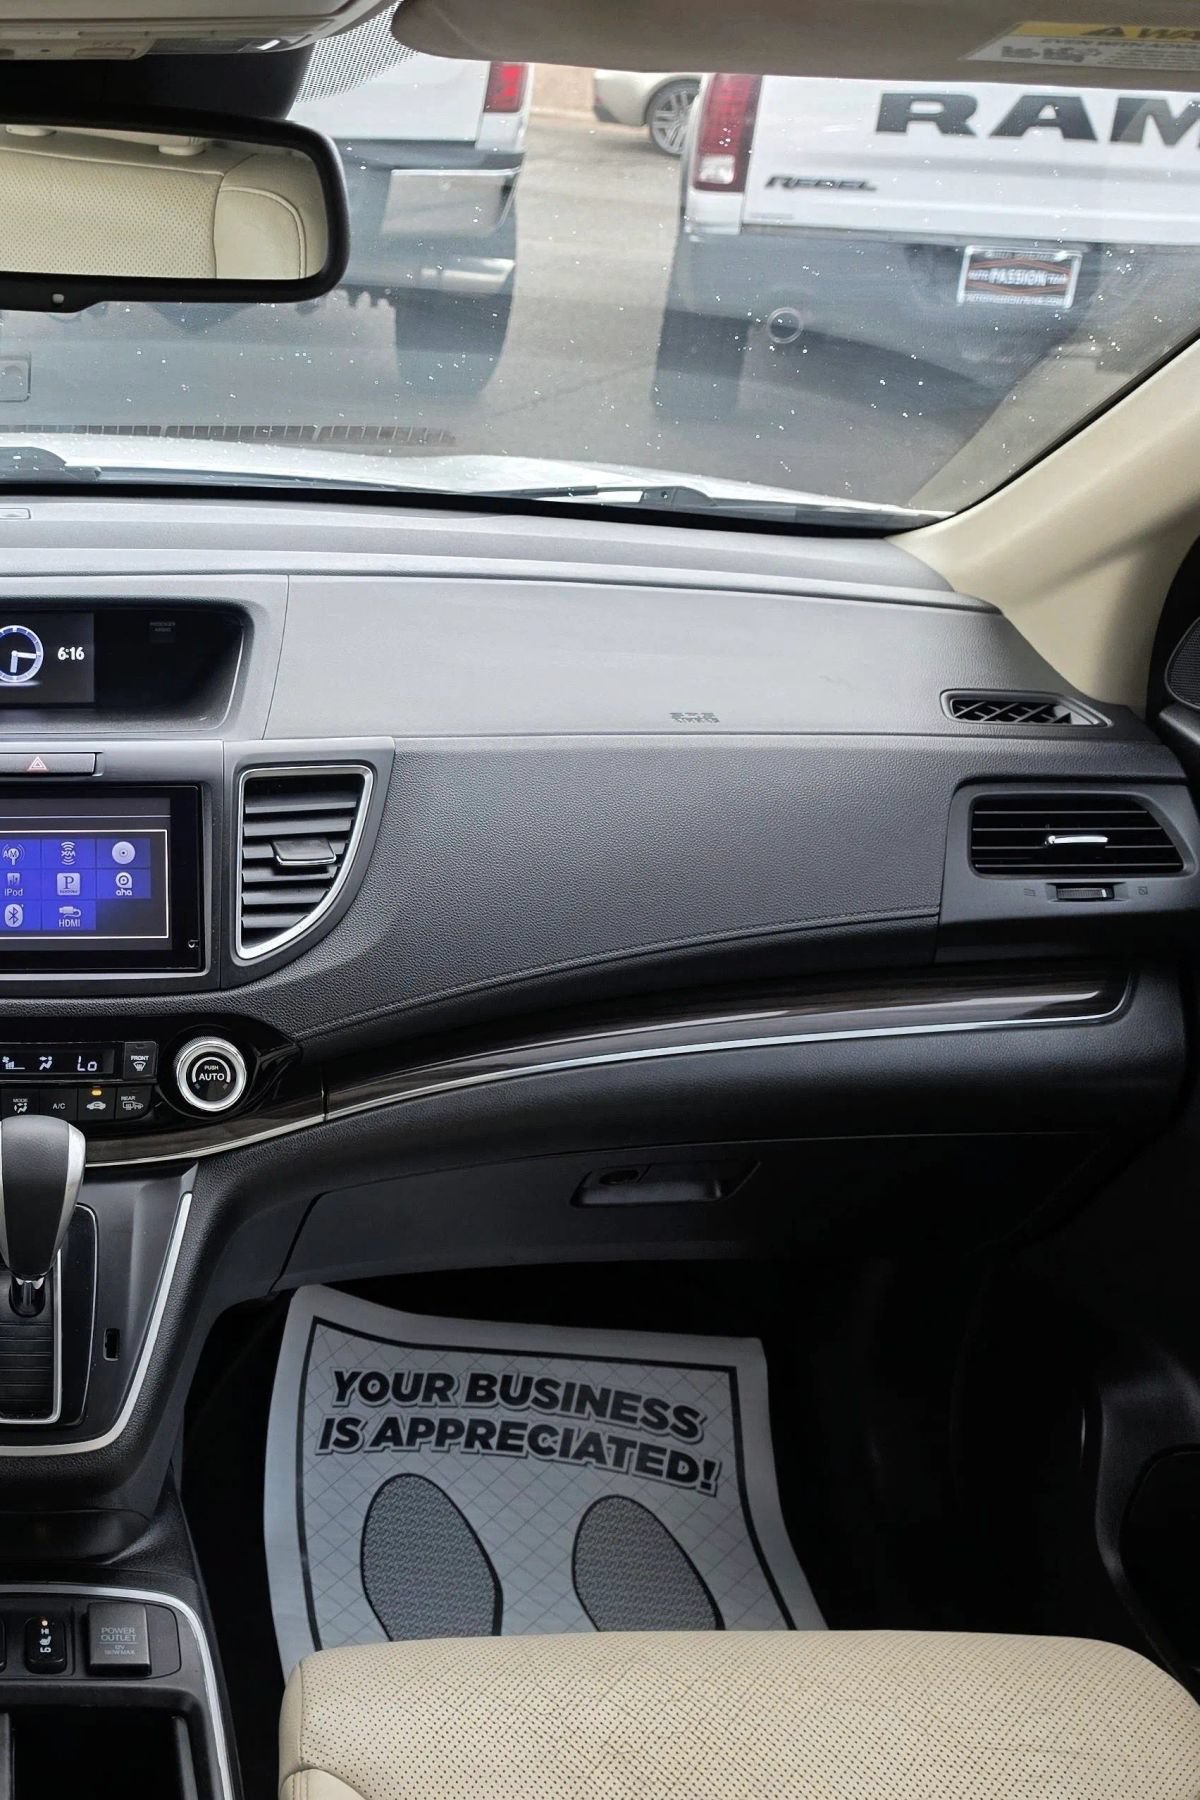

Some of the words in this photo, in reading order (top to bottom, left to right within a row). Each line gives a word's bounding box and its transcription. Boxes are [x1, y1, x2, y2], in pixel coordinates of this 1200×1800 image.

[875, 92, 1200, 147] RAM
[764, 176, 877, 191] REBEL
[58, 647, 84, 660] 6:16
[115, 887, 133, 896] aha
[58, 919, 81, 928] HDMI
[198, 1072, 225, 1082] AUTO
[52, 1102, 65, 1110] A/C
[333, 1370, 456, 1403] YOUR
[464, 1371, 701, 1439] BUSINESS
[318, 1416, 363, 1450] IS
[368, 1416, 719, 1492] APPRECIATED!
